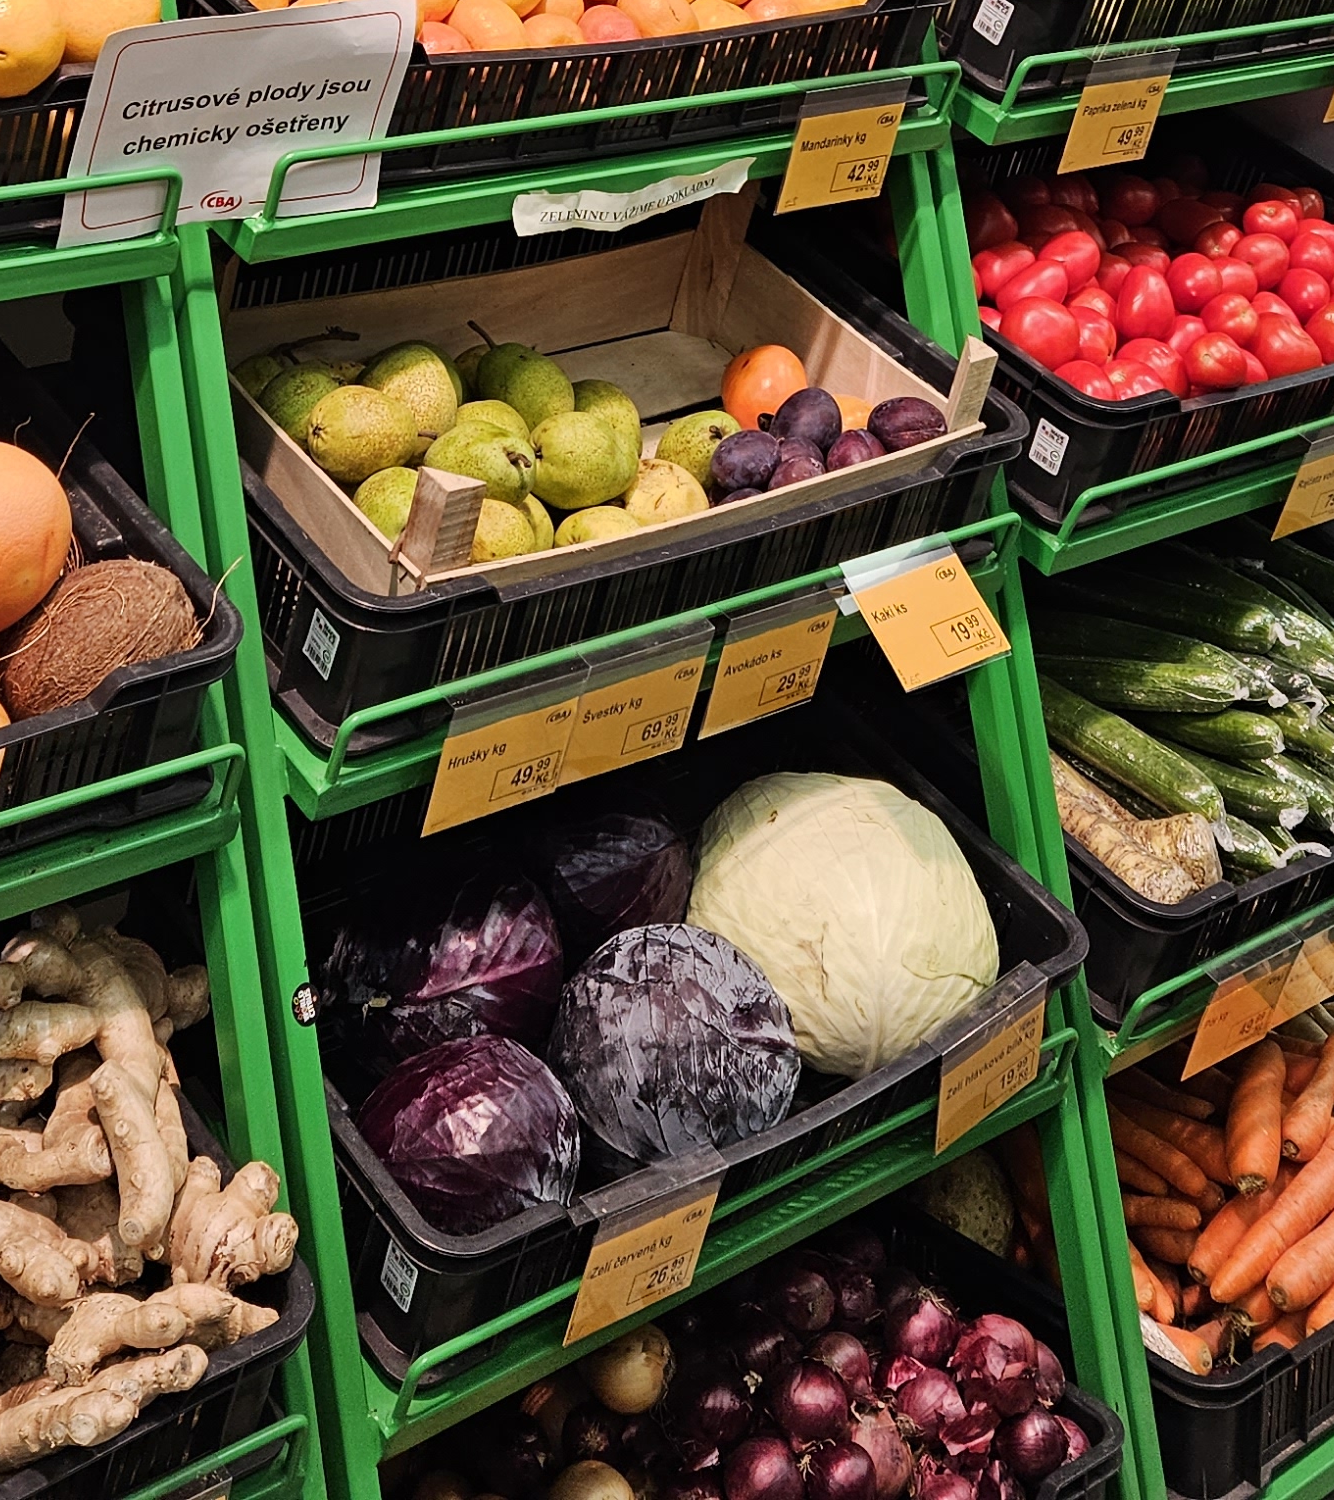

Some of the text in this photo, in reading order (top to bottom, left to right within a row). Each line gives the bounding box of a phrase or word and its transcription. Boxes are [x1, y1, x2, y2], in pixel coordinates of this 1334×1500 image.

[122, 77, 372, 120] Citrusové plody jsou
[1082, 102, 1111, 117] Paprika
[1136, 98, 1147, 110] kg
[123, 112, 350, 156] chemicky ošetřeny
[800, 132, 867, 153] Mandarinky kg
[867, 160, 879, 172] 99
[206, 195, 235, 209] CBA
[539, 177, 719, 223] ZELENINU VÁŽÍME U POKLADNY
[871, 603, 908, 624] Kaki ks
[966, 614, 980, 628] 99
[977, 628, 991, 640] Kč
[724, 649, 782, 677] Avokádo ks
[798, 665, 811, 678] 99
[583, 697, 643, 724] Švestky kg
[665, 713, 679, 727] 99
[665, 727, 678, 739] Kč
[448, 742, 507, 770] Hrušky kg
[536, 757, 550, 772] 99
[535, 772, 550, 785] Kč
[965, 1054, 1005, 1087] hlávkové
[590, 1235, 673, 1280] Zelí červené kg
[671, 1257, 685, 1272] 99
